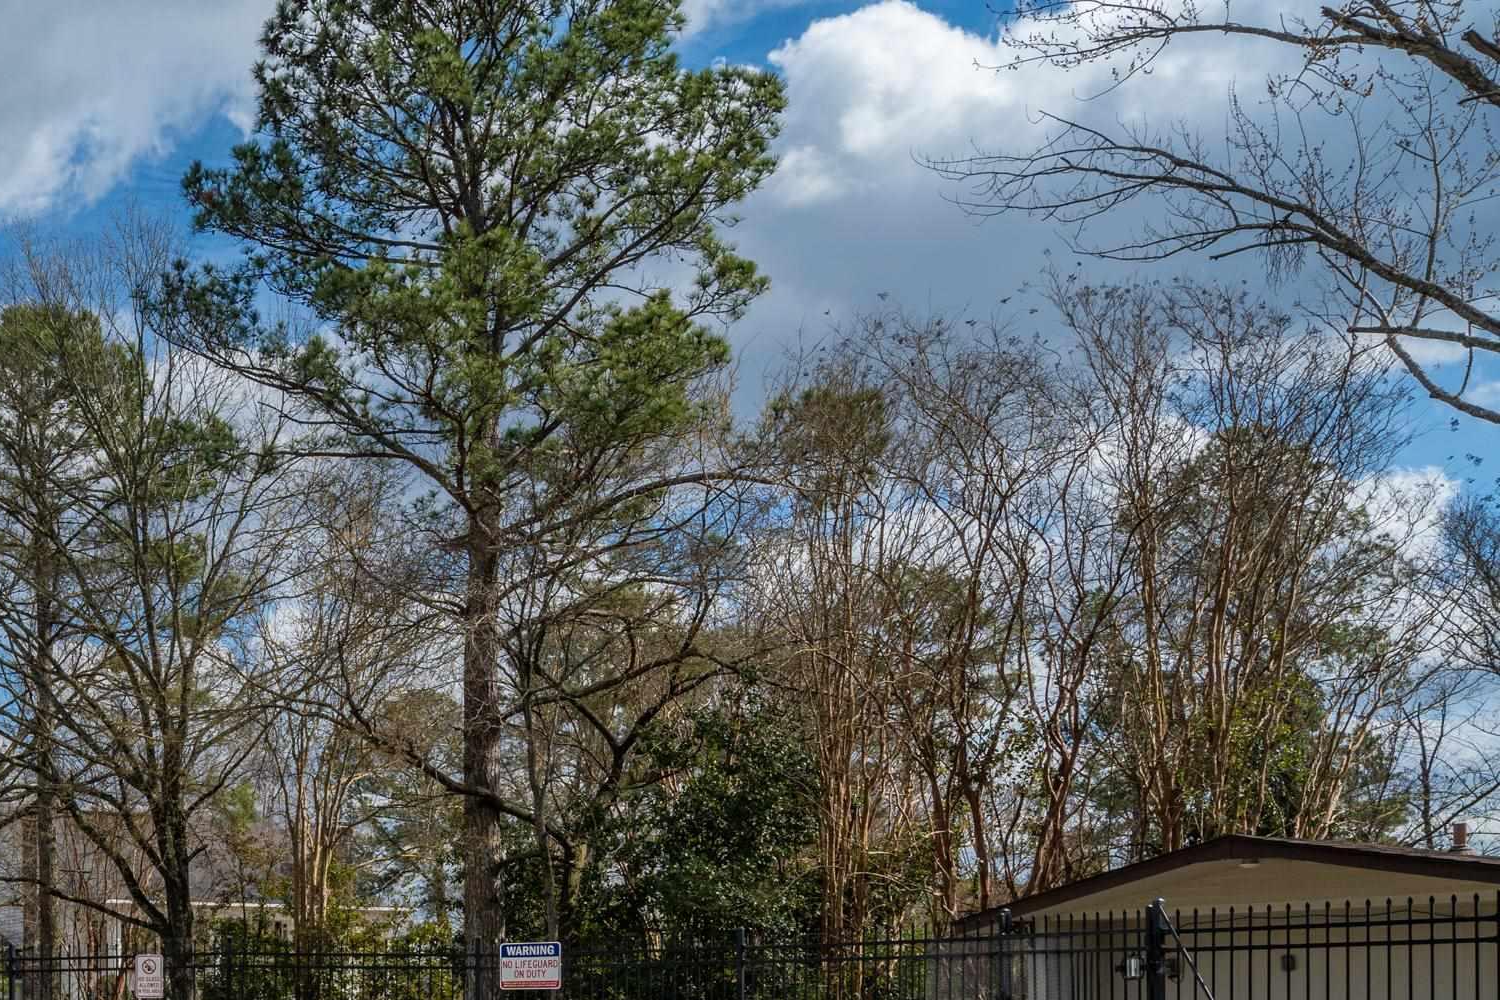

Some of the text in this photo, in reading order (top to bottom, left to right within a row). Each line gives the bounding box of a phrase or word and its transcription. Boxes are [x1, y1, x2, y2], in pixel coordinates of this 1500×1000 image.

[506, 945, 555, 956] WARNING
[502, 959, 558, 969] NO LIFEGUARD
[514, 969, 547, 978] ON DUTY
